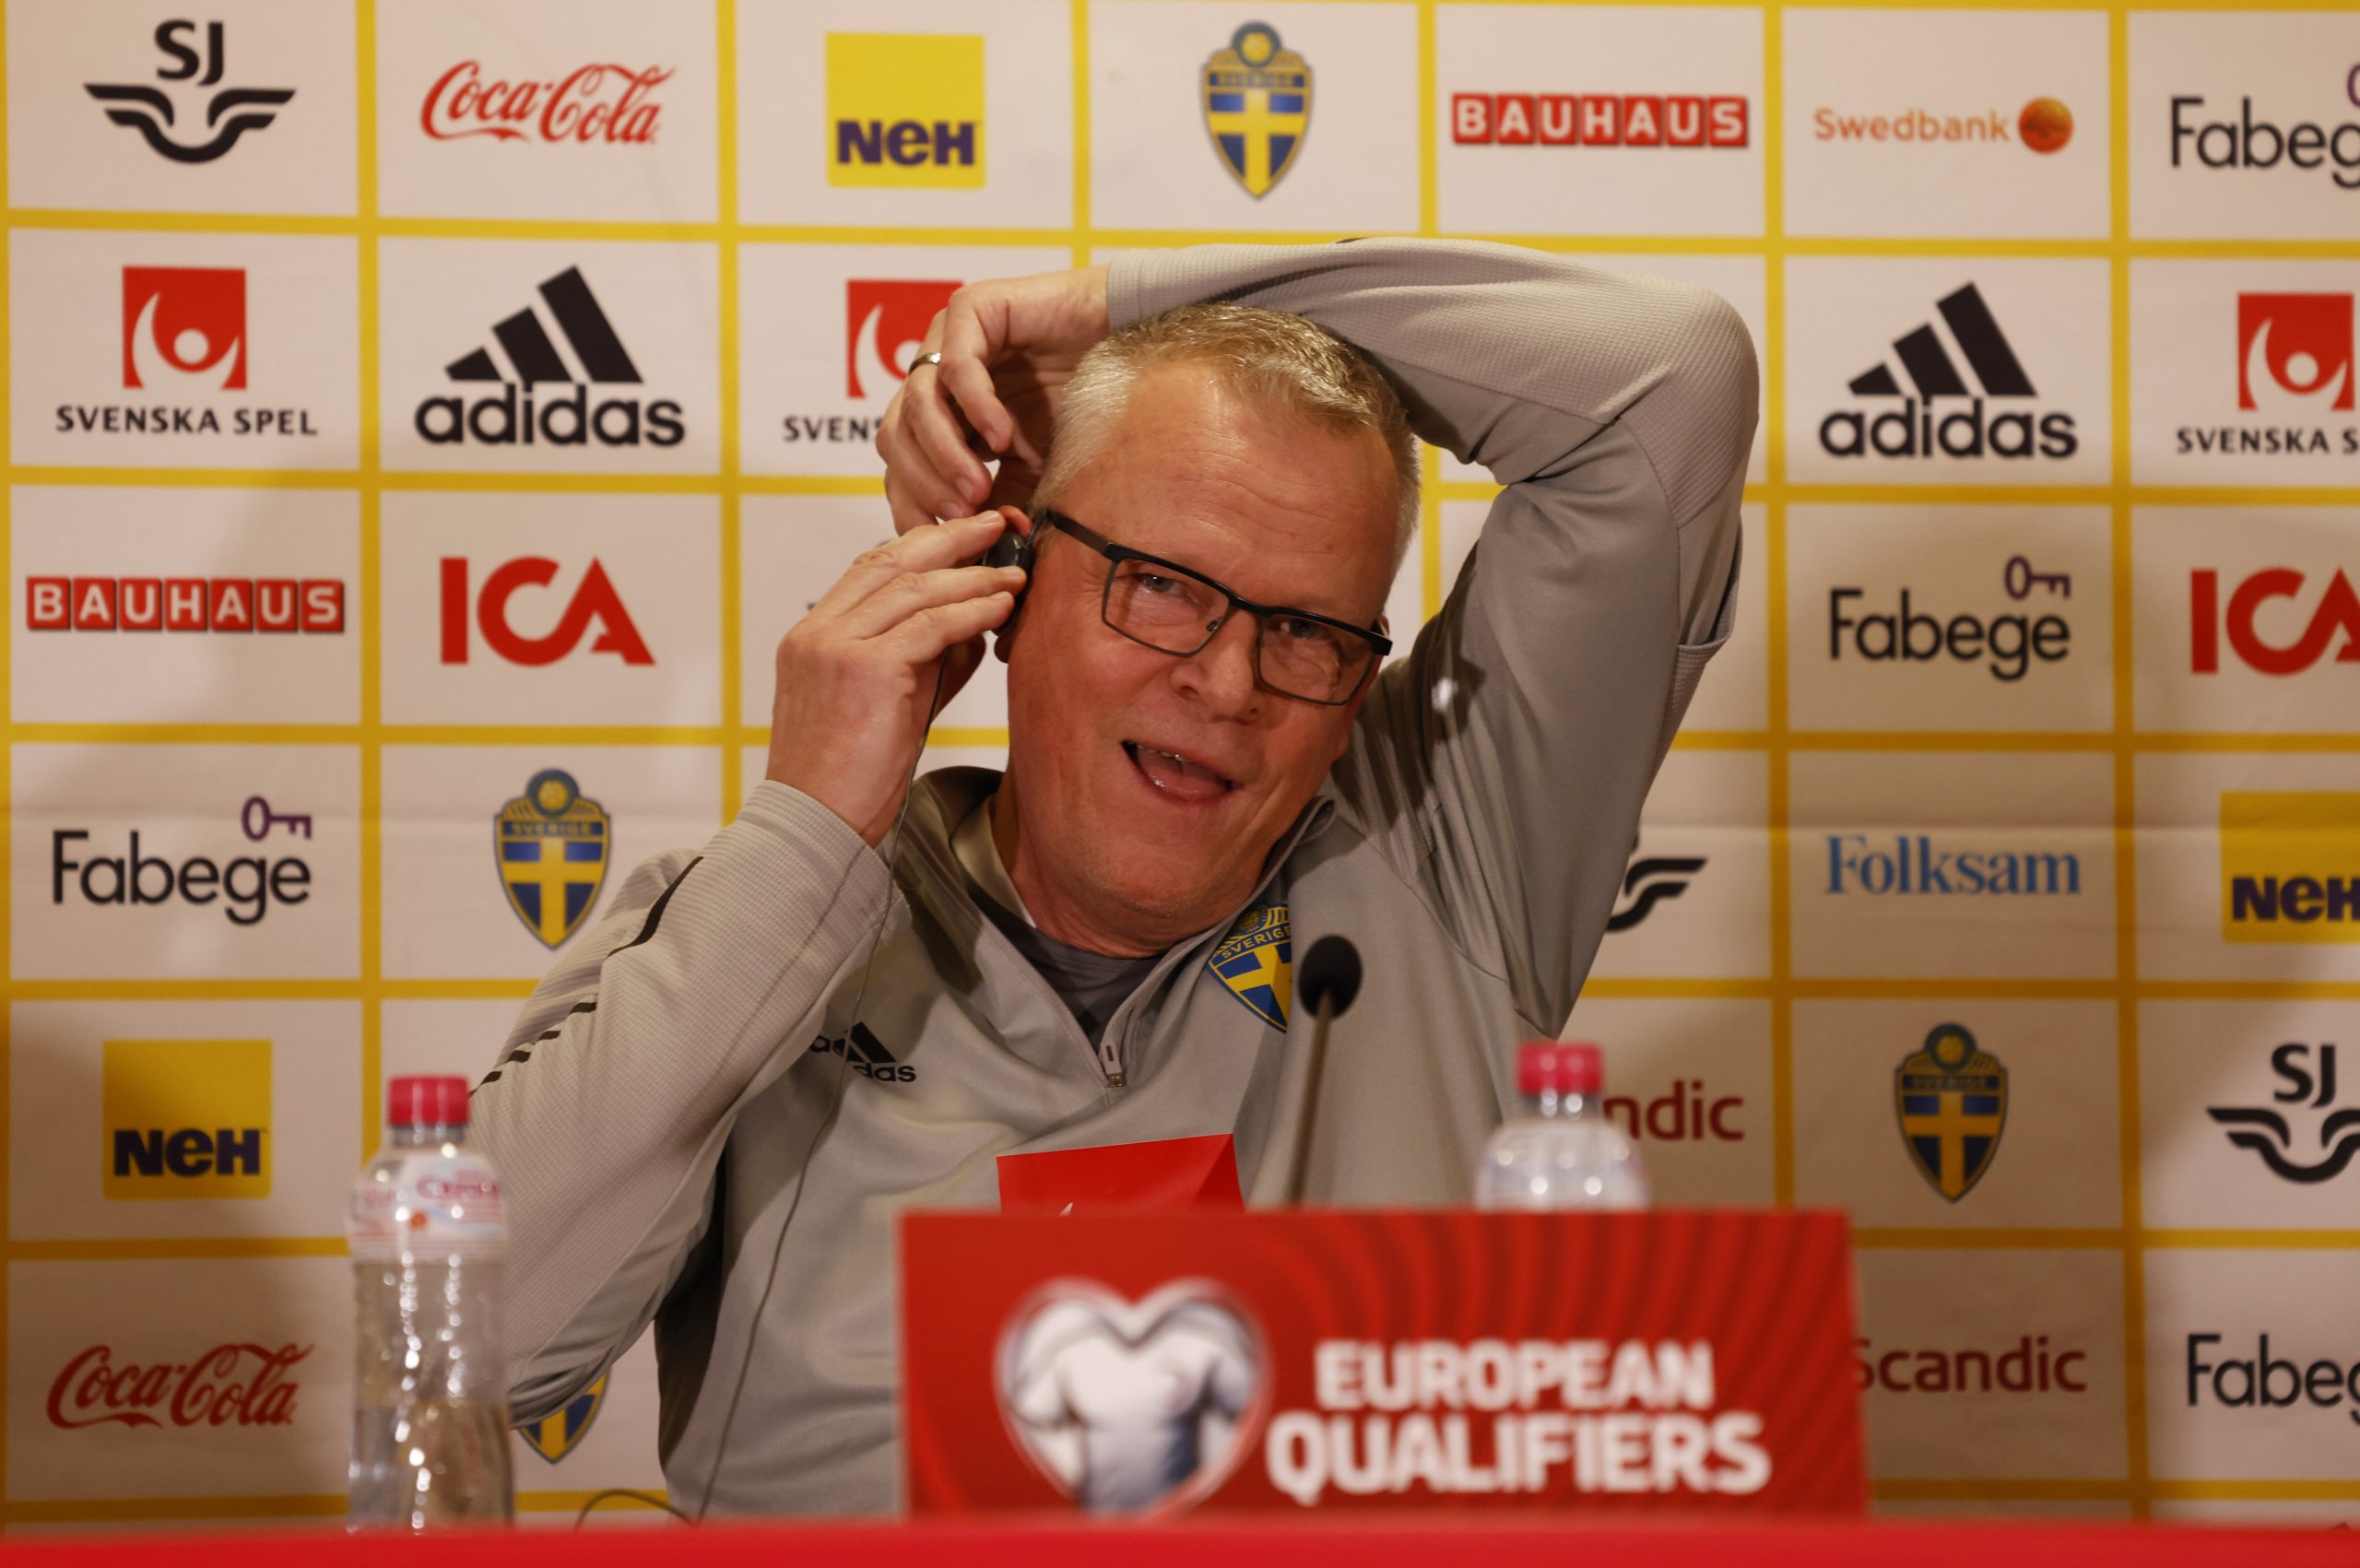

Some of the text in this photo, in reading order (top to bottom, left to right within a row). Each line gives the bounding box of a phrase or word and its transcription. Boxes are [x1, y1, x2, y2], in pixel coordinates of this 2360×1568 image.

[154, 18, 224, 86] SJ
[420, 60, 675, 144] Coca-Cola
[1454, 96, 1745, 141] BAUHAUS
[1813, 107, 2010, 143] Swedbank
[2171, 96, 2360, 190] Fabeg
[56, 405, 317, 435] SVENSKA SPEL
[414, 383, 686, 447] adidas
[783, 416, 883, 442] SVEN
[1819, 400, 2078, 460] adidas
[2177, 427, 2330, 454] SVENSKA
[30, 581, 340, 626] BAUHAUS
[440, 555, 656, 667] ICA
[1830, 588, 2071, 682] Fabege
[53, 829, 312, 925] Fabege
[1824, 835, 2082, 895] Folksam
[2271, 1043, 2337, 1108] SJ
[1602, 1079, 1745, 1142] ndic
[46, 1342, 315, 1431] Coca-Cola
[1314, 1339, 1715, 1410] EUROPEAN
[2187, 1333, 2360, 1427] Fabe
[1266, 1412, 1771, 1503] QUALIFIERS
